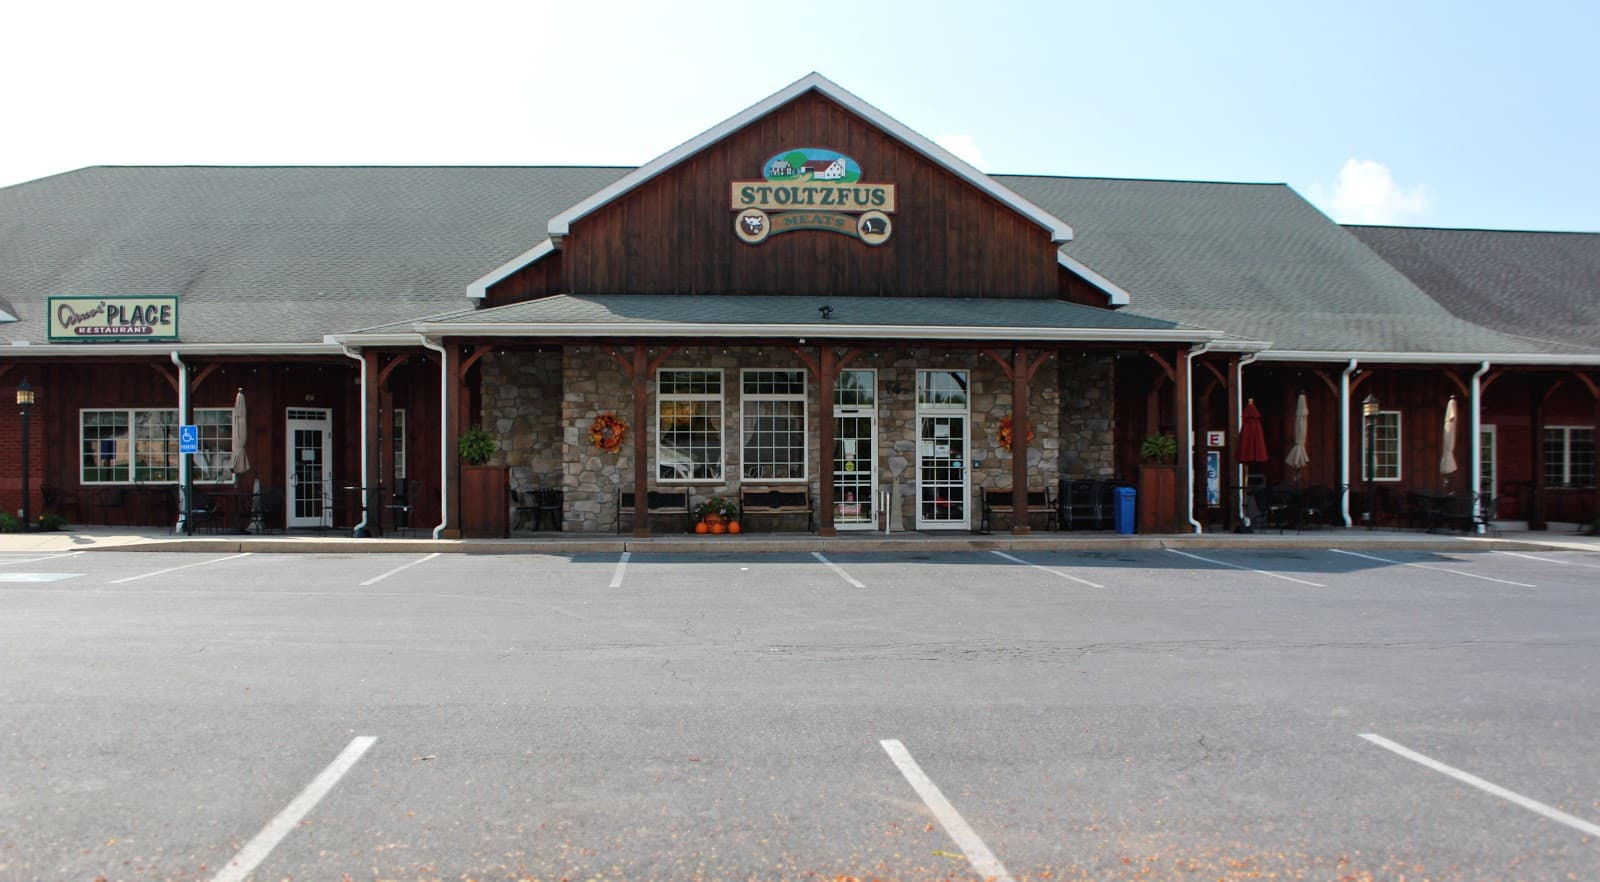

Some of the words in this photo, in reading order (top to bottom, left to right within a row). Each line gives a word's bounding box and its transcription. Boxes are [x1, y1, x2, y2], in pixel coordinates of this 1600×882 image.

[741, 186, 885, 205] STOLTZFUS
[784, 215, 844, 226] MEATS
[107, 304, 171, 325] PLACE
